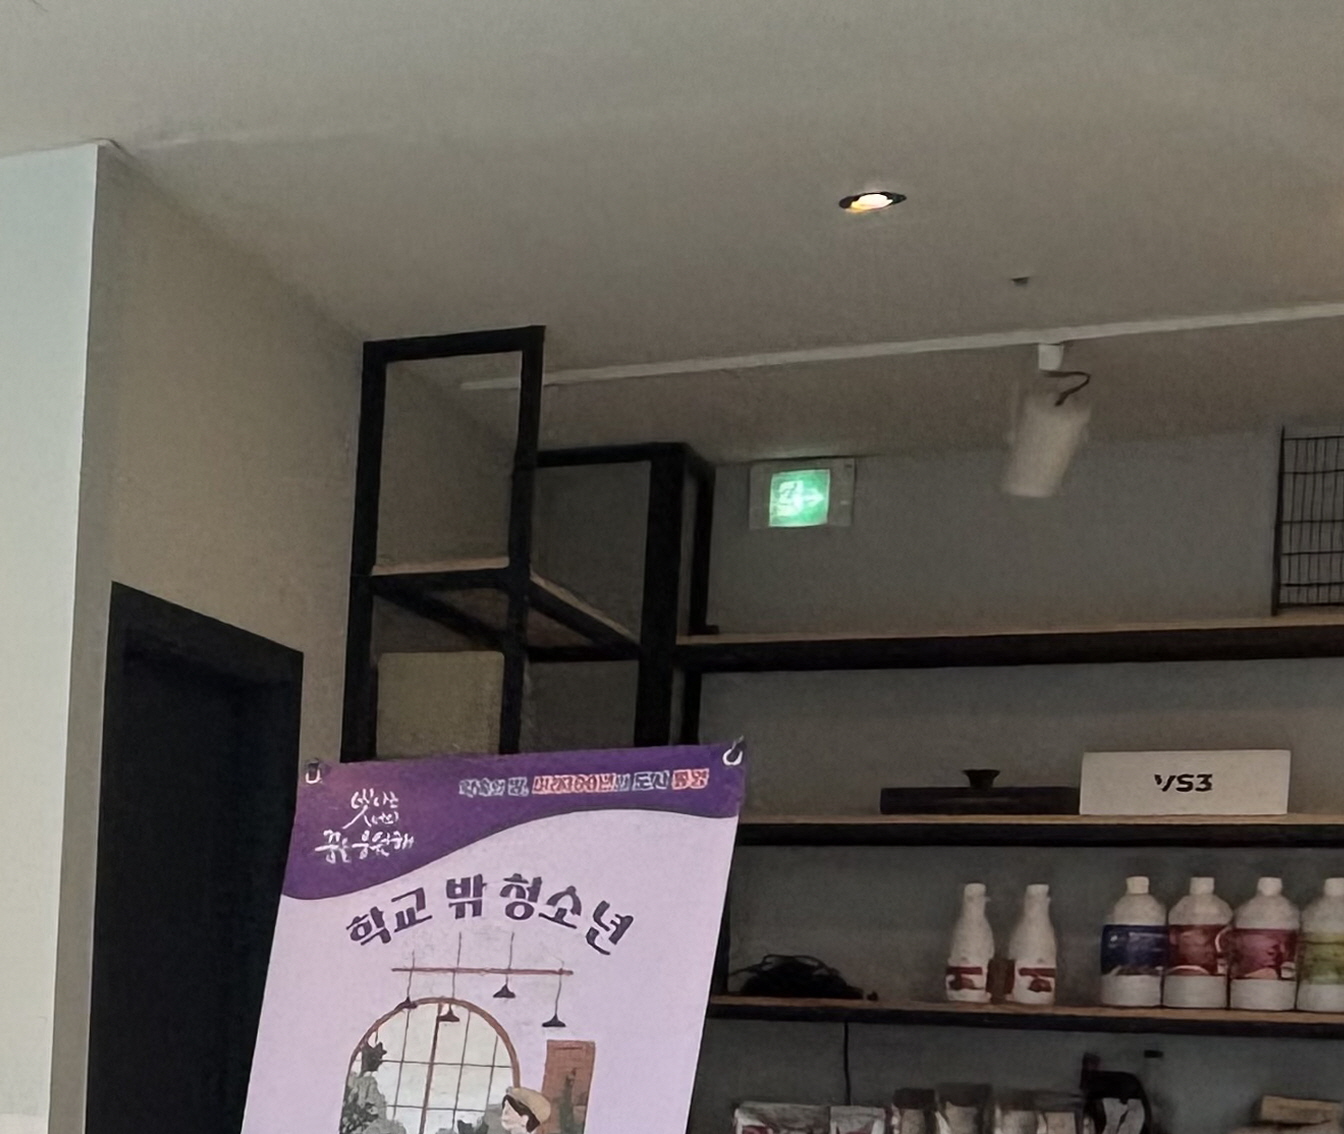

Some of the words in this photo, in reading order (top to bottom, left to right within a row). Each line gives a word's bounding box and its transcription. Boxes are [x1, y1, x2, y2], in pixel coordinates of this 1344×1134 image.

[1154, 773, 1213, 792] VS3
[346, 886, 433, 946] 학교
[445, 873, 488, 920] 밖
[499, 873, 634, 955] 청소년
